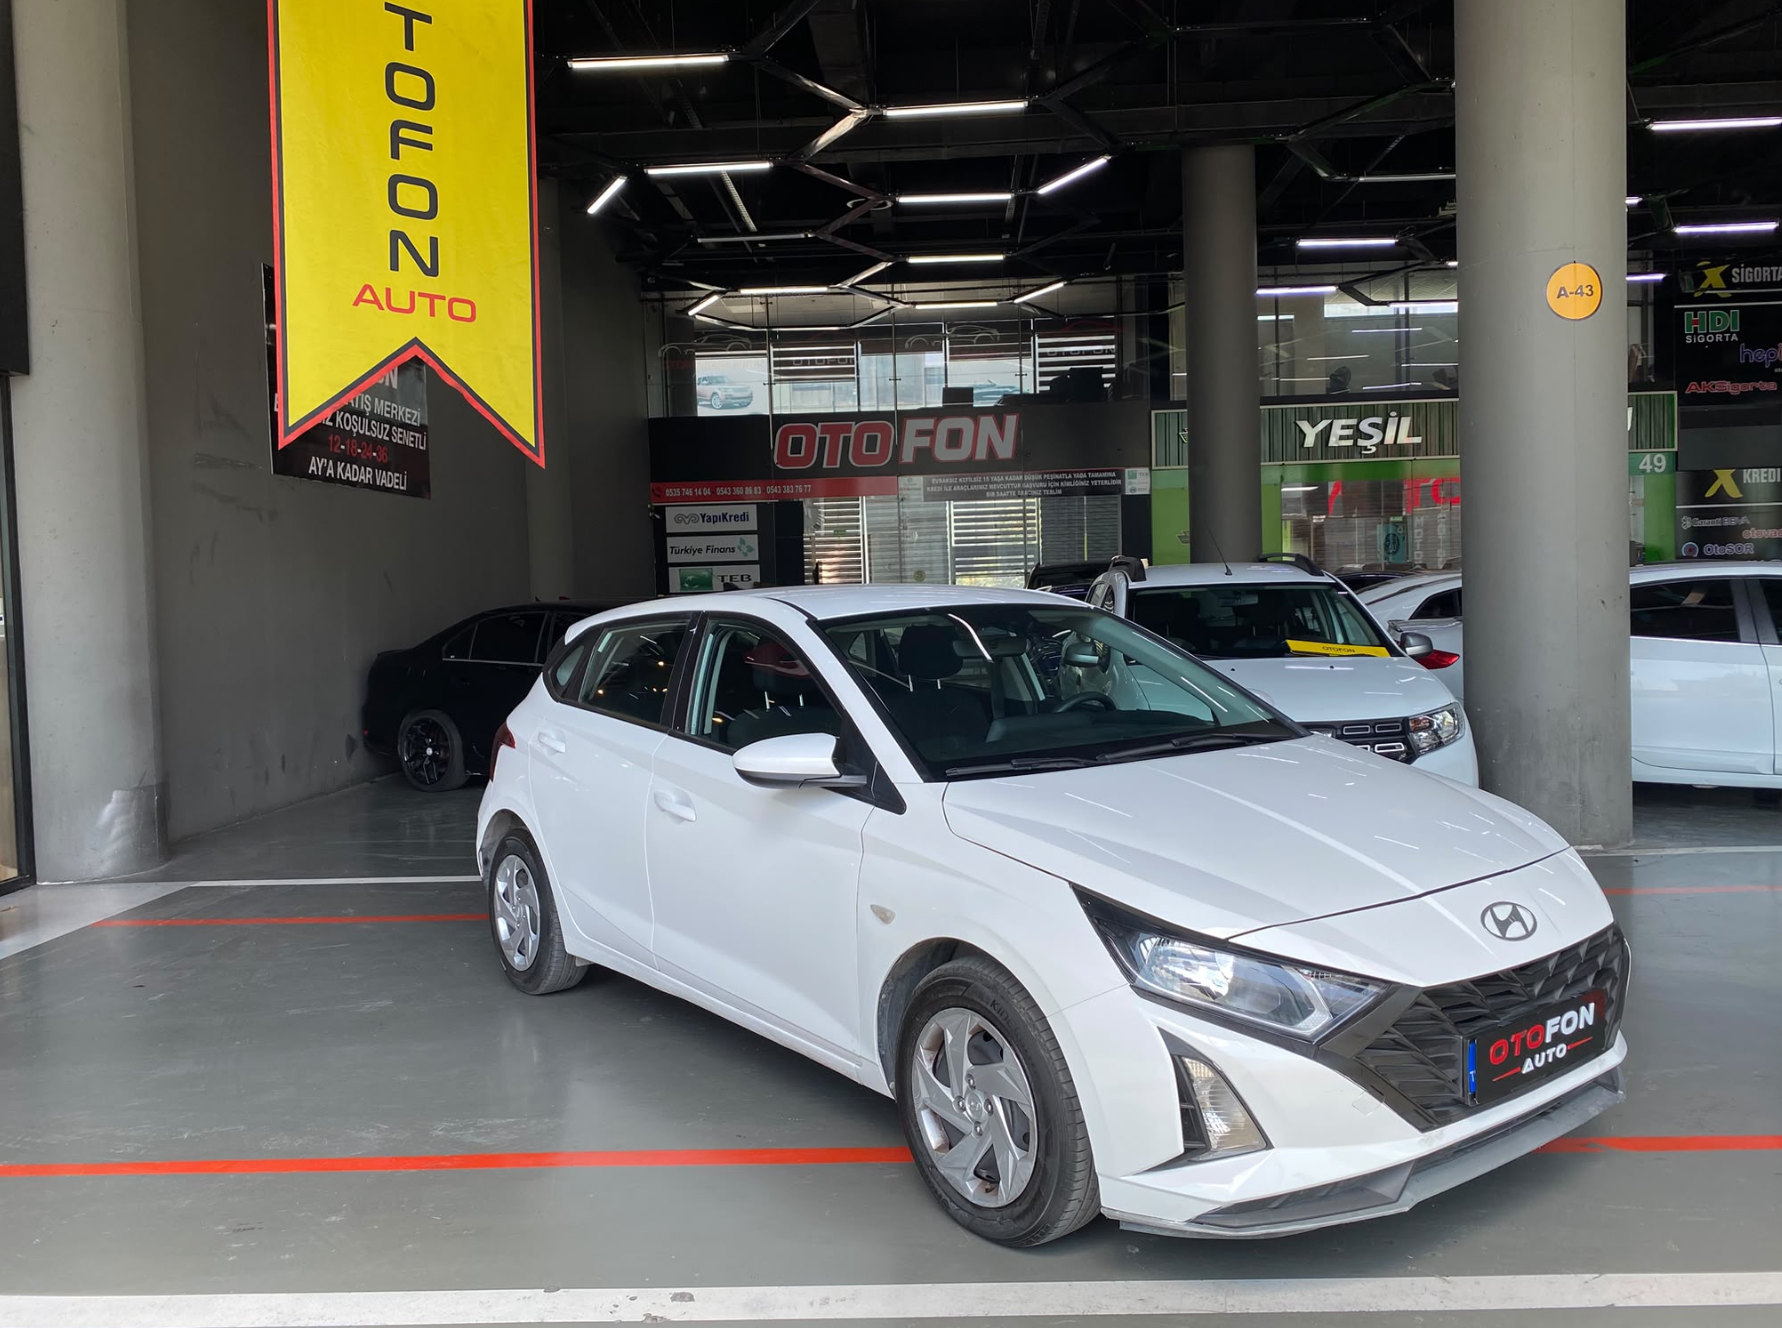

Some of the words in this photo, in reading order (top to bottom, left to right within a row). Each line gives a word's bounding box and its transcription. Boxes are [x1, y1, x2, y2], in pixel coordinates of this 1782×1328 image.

[352, 284, 477, 323] AUTO
[1556, 284, 1594, 299] A-43
[1684, 310, 1740, 333] HDI
[1685, 380, 1777, 395] AKSigorta
[373, 397, 421, 427] MERKEZİ
[336, 410, 390, 440] KOŞULSUZ
[391, 425, 427, 450] SENETLİ
[1295, 411, 1422, 454] YEŞİL
[337, 461, 373, 485] KADAR
[375, 469, 407, 490] VADELİ
[1639, 453, 1667, 473] 49
[669, 545, 703, 556] Türkiye
[705, 544, 736, 553] Finans
[1703, 542, 1754, 555] OtoSOR
[717, 574, 752, 583] TEB
[1489, 1002, 1595, 1066] OTOFON
[1521, 1043, 1567, 1075] AUTO
